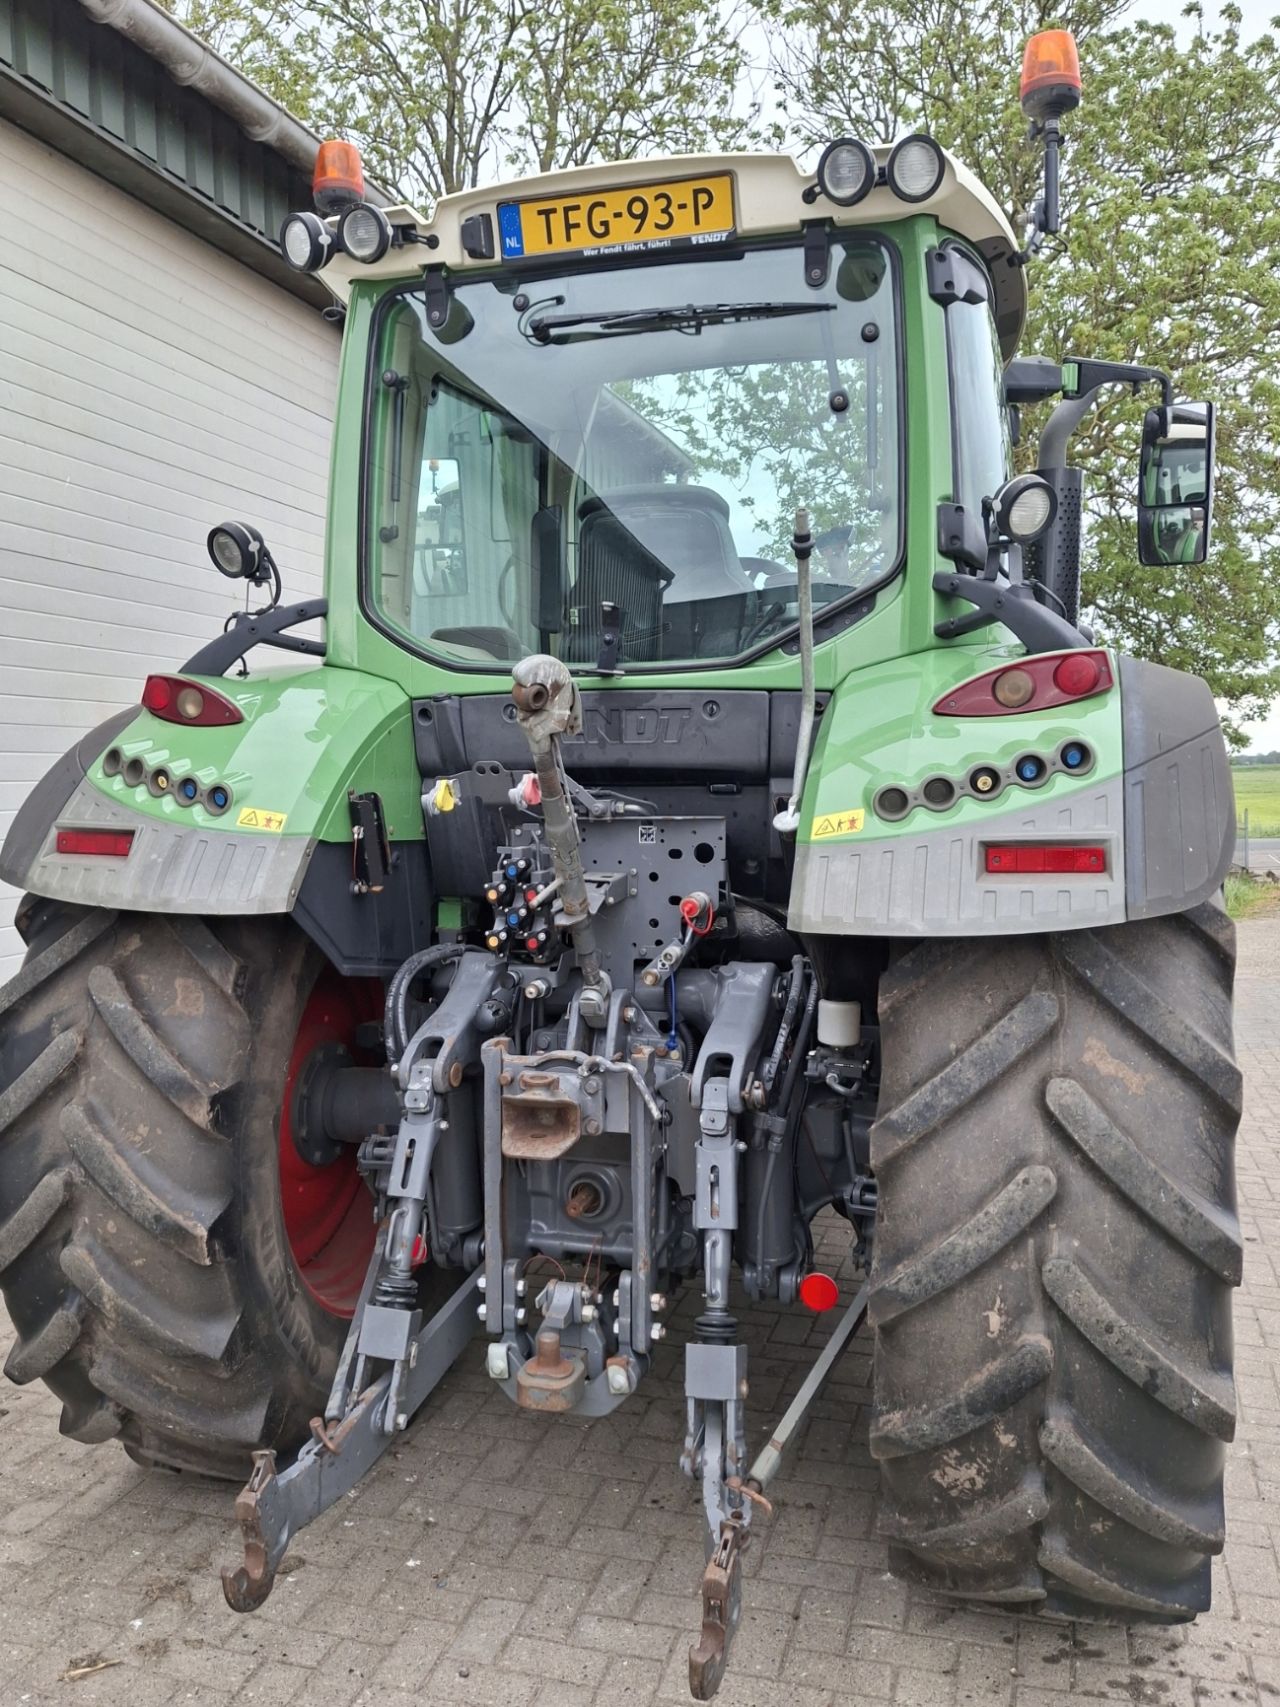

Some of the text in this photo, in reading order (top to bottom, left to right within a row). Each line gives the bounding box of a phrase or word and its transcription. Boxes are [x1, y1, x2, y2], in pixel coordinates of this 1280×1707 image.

[537, 187, 714, 244] TFG-93-P
[506, 237, 520, 248] NL
[691, 232, 729, 244] FENDT
[583, 248, 598, 256] Wer
[600, 245, 622, 254] Fendt
[560, 708, 692, 744] NDT
